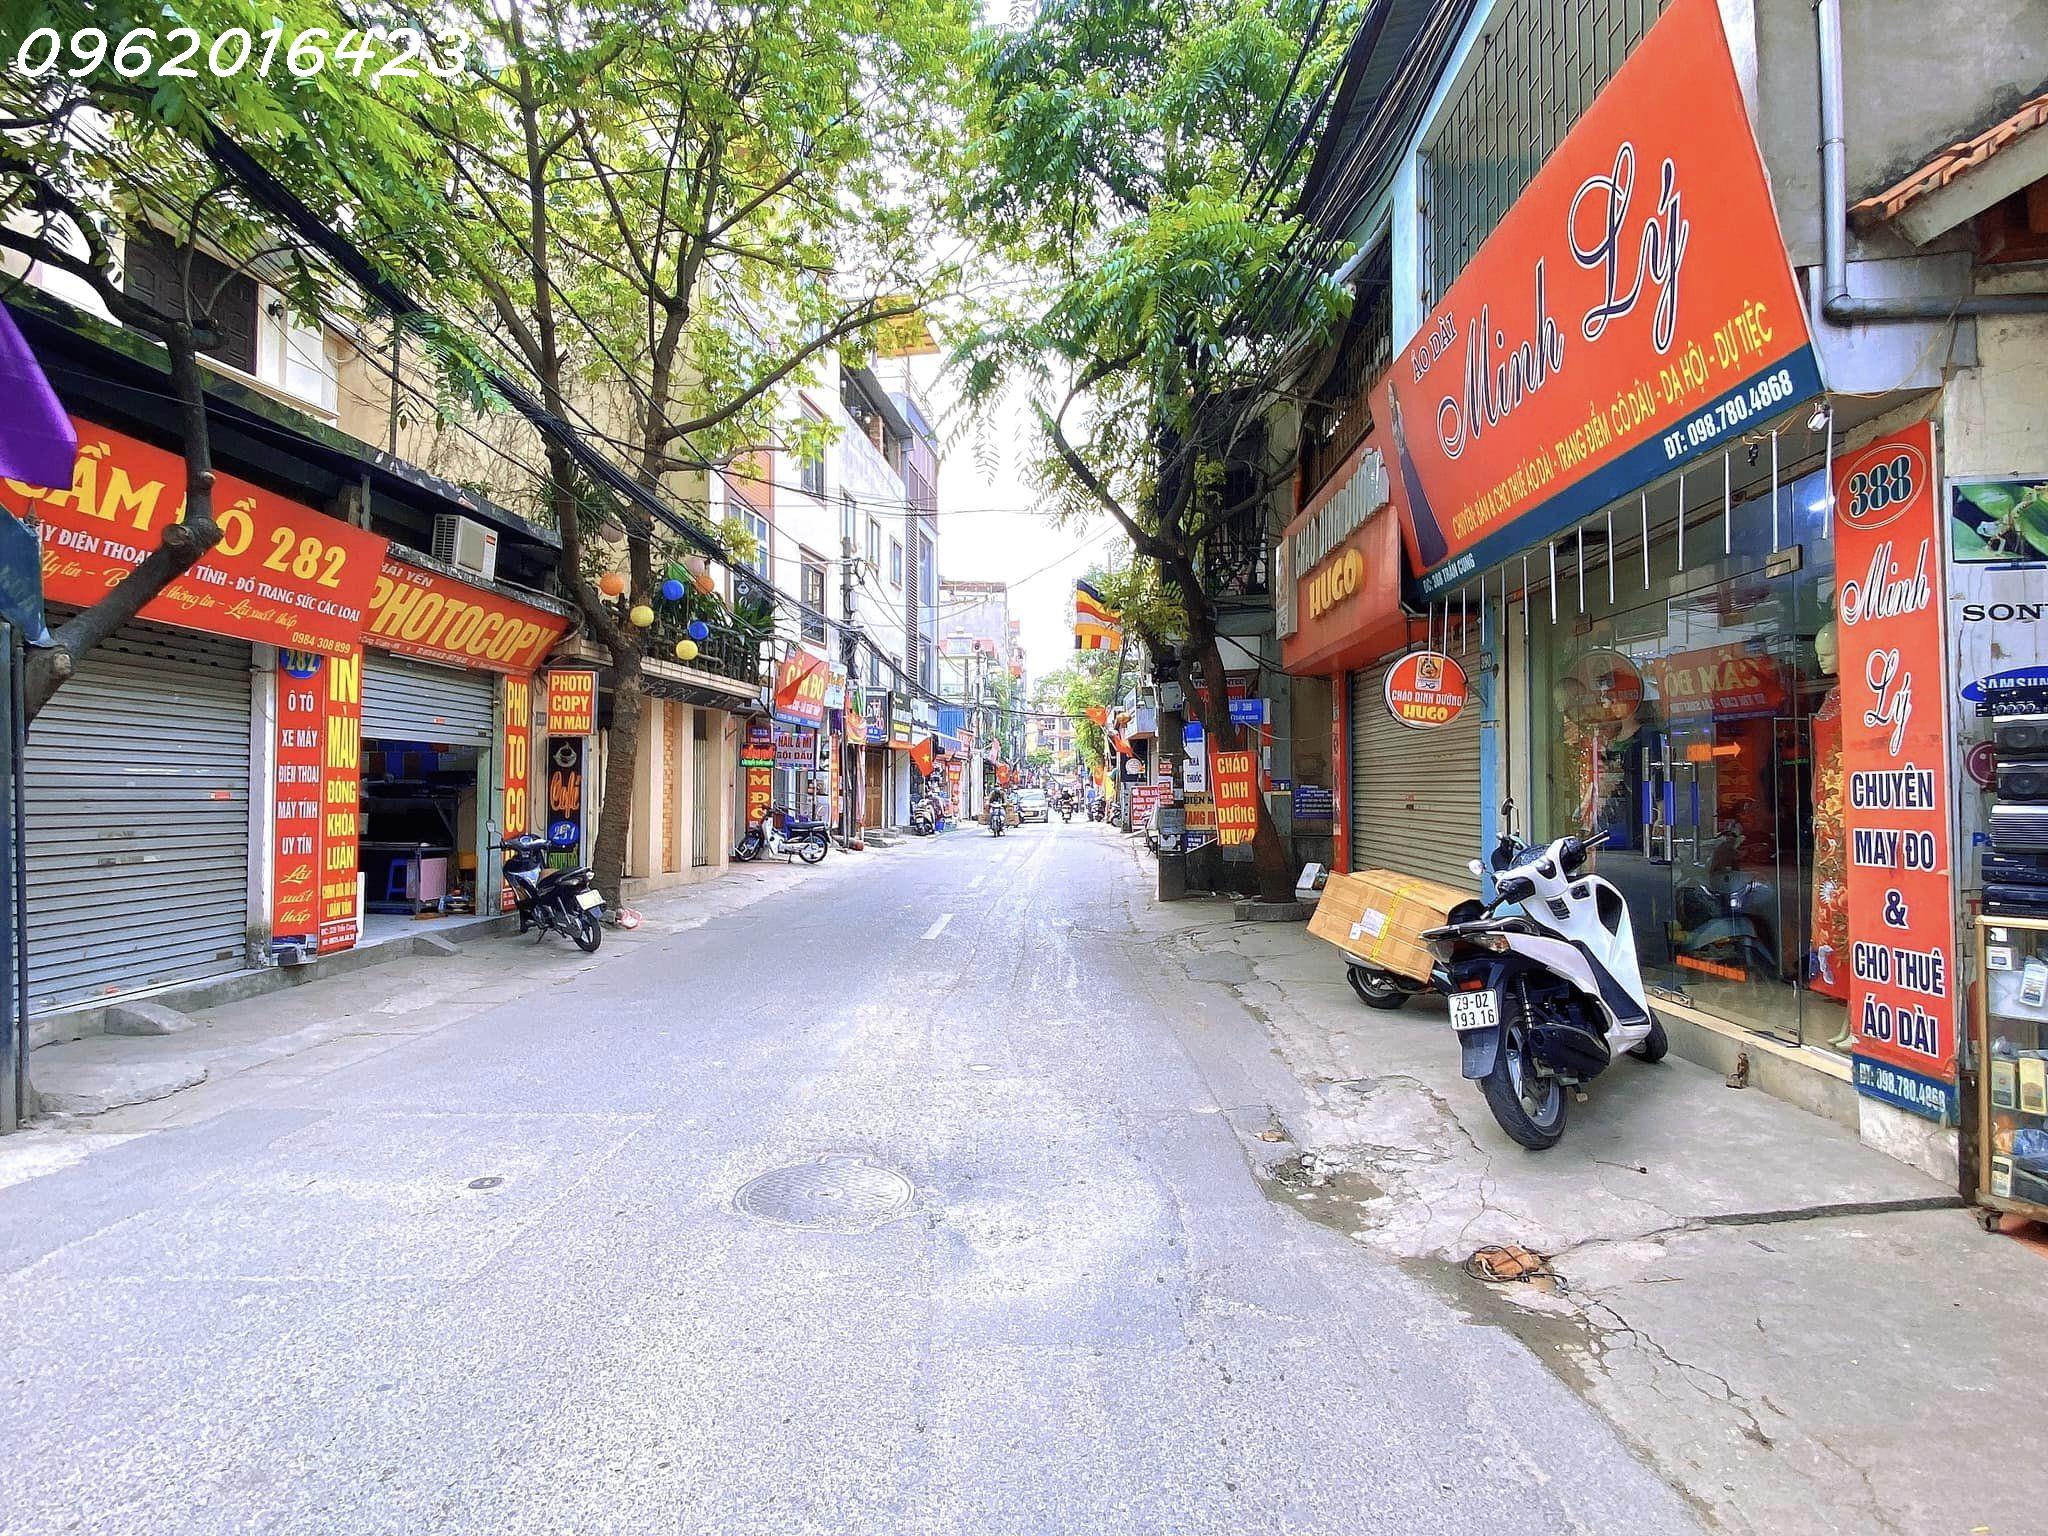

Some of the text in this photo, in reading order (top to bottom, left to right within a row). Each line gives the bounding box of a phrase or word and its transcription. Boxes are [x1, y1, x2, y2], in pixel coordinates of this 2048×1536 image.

[1437, 141, 1690, 459] Minh Lý
[1411, 311, 1458, 384] ÁO DÀI
[1493, 480, 1512, 513] CHO
[1523, 457, 1540, 493] ÁO
[1537, 446, 1555, 485] DÀI
[1555, 430, 1588, 472] TRANG
[1585, 401, 1613, 453] ĐIỂM
[1611, 391, 1631, 435] CÔ
[1628, 379, 1656, 425] DÂU
[1660, 364, 1685, 406] DẠ
[1679, 340, 1709, 393] HỘI
[1735, 299, 1773, 357] TIỆC
[1686, 368, 1794, 447] 098.780.4868
[1849, 454, 1912, 517] 388
[58, 531, 100, 554] ĐIỆN
[175, 491, 256, 556] Ồ
[262, 526, 346, 588] 282
[195, 563, 228, 586] TÍNH
[235, 575, 255, 593] ĐỒ
[257, 583, 295, 604] TRANG
[295, 593, 316, 611] SỨC
[317, 599, 338, 616] CÁC
[338, 605, 361, 624] LOẠI
[405, 571, 434, 588] YẾN
[1309, 548, 1364, 620] HUGO
[1839, 537, 1931, 625] Minh
[368, 575, 562, 666] PHOTOCOPY
[292, 631, 315, 647] 0984
[334, 641, 352, 654] 899
[329, 653, 360, 704] IN
[551, 674, 592, 692] PHOTO
[1392, 690, 1413, 701] CHÁO
[1414, 692, 1434, 704] DINH
[287, 690, 315, 712] Ô TÔ
[507, 681, 529, 728] PHO
[549, 715, 562, 730] IN
[564, 712, 591, 730] MÀU
[552, 695, 590, 712] COPY
[1403, 703, 1449, 721] HUGO
[1863, 648, 1912, 756] Lý
[281, 726, 319, 748] XE MÁY
[327, 704, 360, 769] MÀU
[507, 734, 526, 780] TO
[278, 761, 320, 787] ĐIỆN THOẠI
[1217, 754, 1249, 774] CHÁO
[277, 797, 318, 819] MÁY TÍNH
[327, 776, 357, 804] ĐÓNG
[1221, 781, 1248, 799] DINH
[1850, 763, 1936, 811] CHUYÊN
[326, 808, 356, 838] KHÓA
[505, 787, 526, 833] CO
[1218, 804, 1256, 824] DƯỠNG
[282, 833, 313, 855] UY TÍN
[326, 841, 355, 874] LUẬN
[1853, 828, 1902, 868] MAY
[1902, 829, 1936, 872] ĐO
[1881, 889, 1910, 931] &
[1852, 941, 1946, 997] CHO THUÊ
[1453, 1009, 1496, 1029] 193.16
[1861, 992, 1940, 1058] ÁO DÀI
